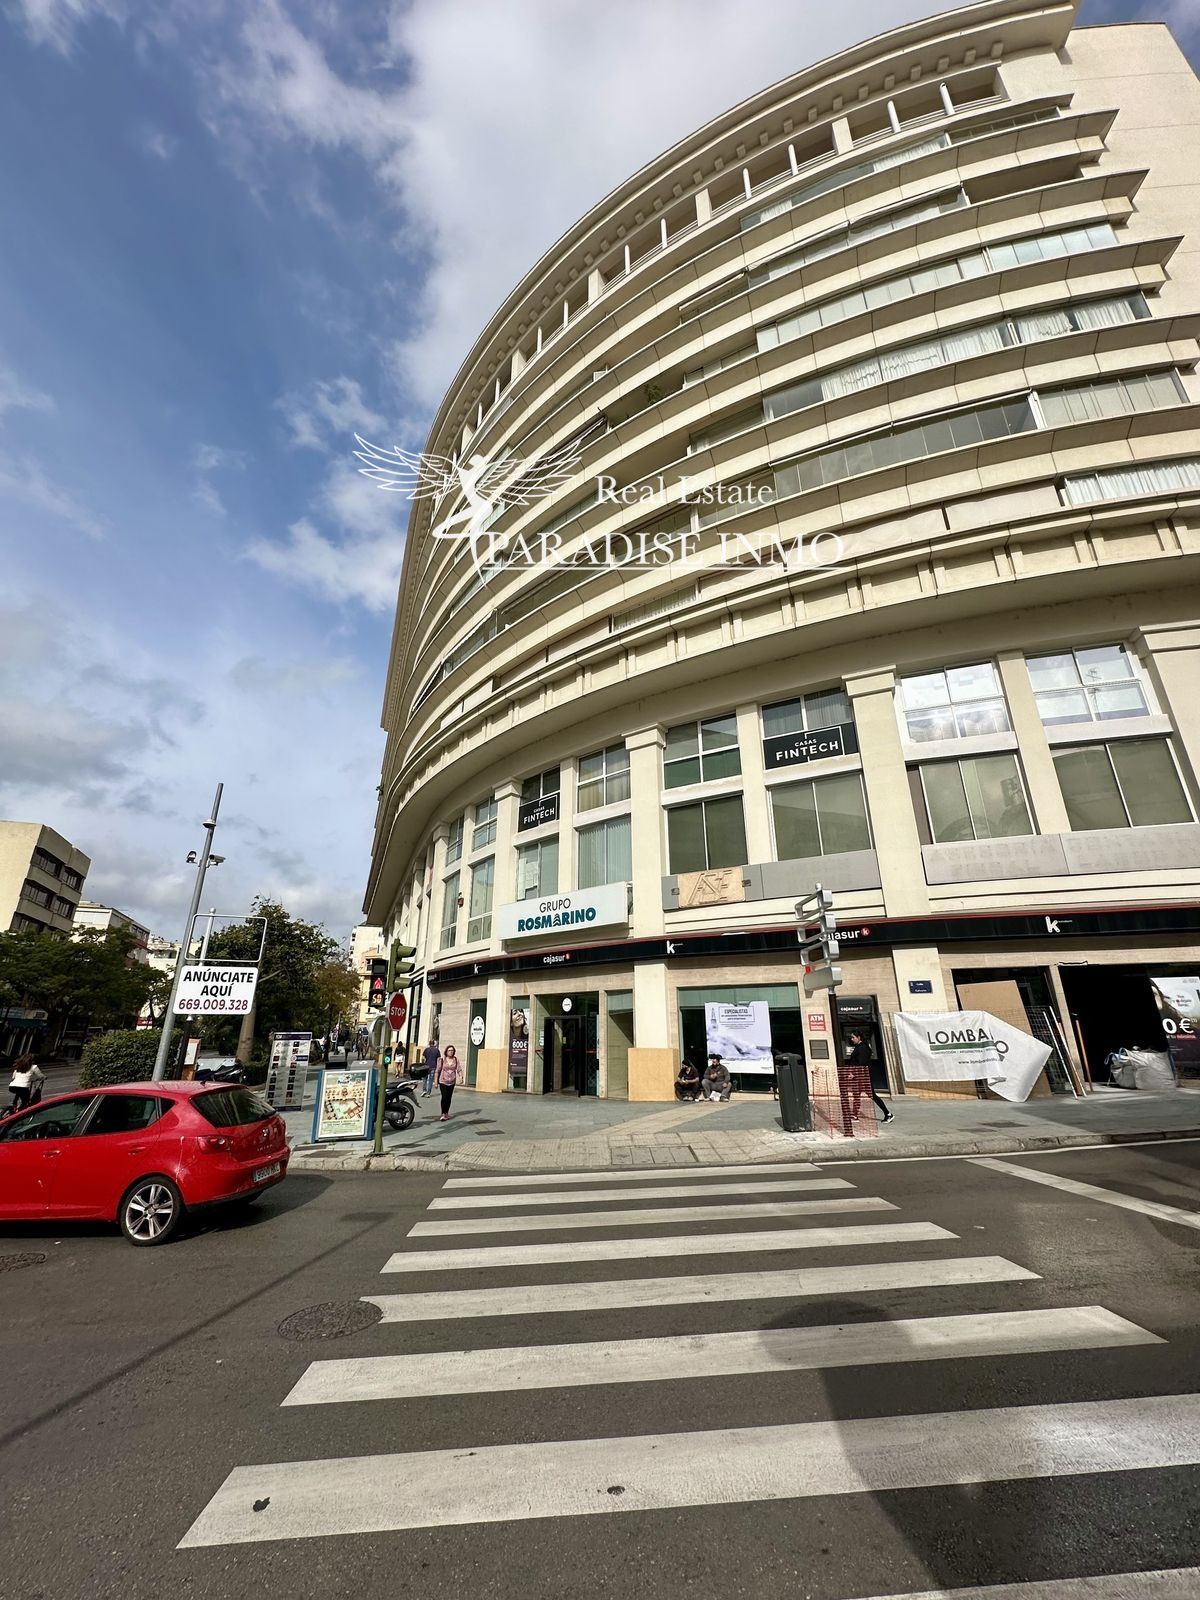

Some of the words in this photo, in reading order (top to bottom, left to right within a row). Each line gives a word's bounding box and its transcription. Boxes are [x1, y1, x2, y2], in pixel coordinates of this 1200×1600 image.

[775, 740, 839, 761] FINTECH
[794, 738, 818, 748] CASAS
[523, 808, 556, 824] FINTECH
[539, 897, 571, 913] GRUPO
[517, 907, 597, 933] ROSMARINO
[819, 930, 861, 941] jasur
[543, 954, 565, 964] cajasur
[183, 967, 254, 984] ANÚNCIATE
[200, 982, 233, 997] AQUÍ
[178, 998, 249, 1012] 669.009.328
[390, 1006, 406, 1017] STOP
